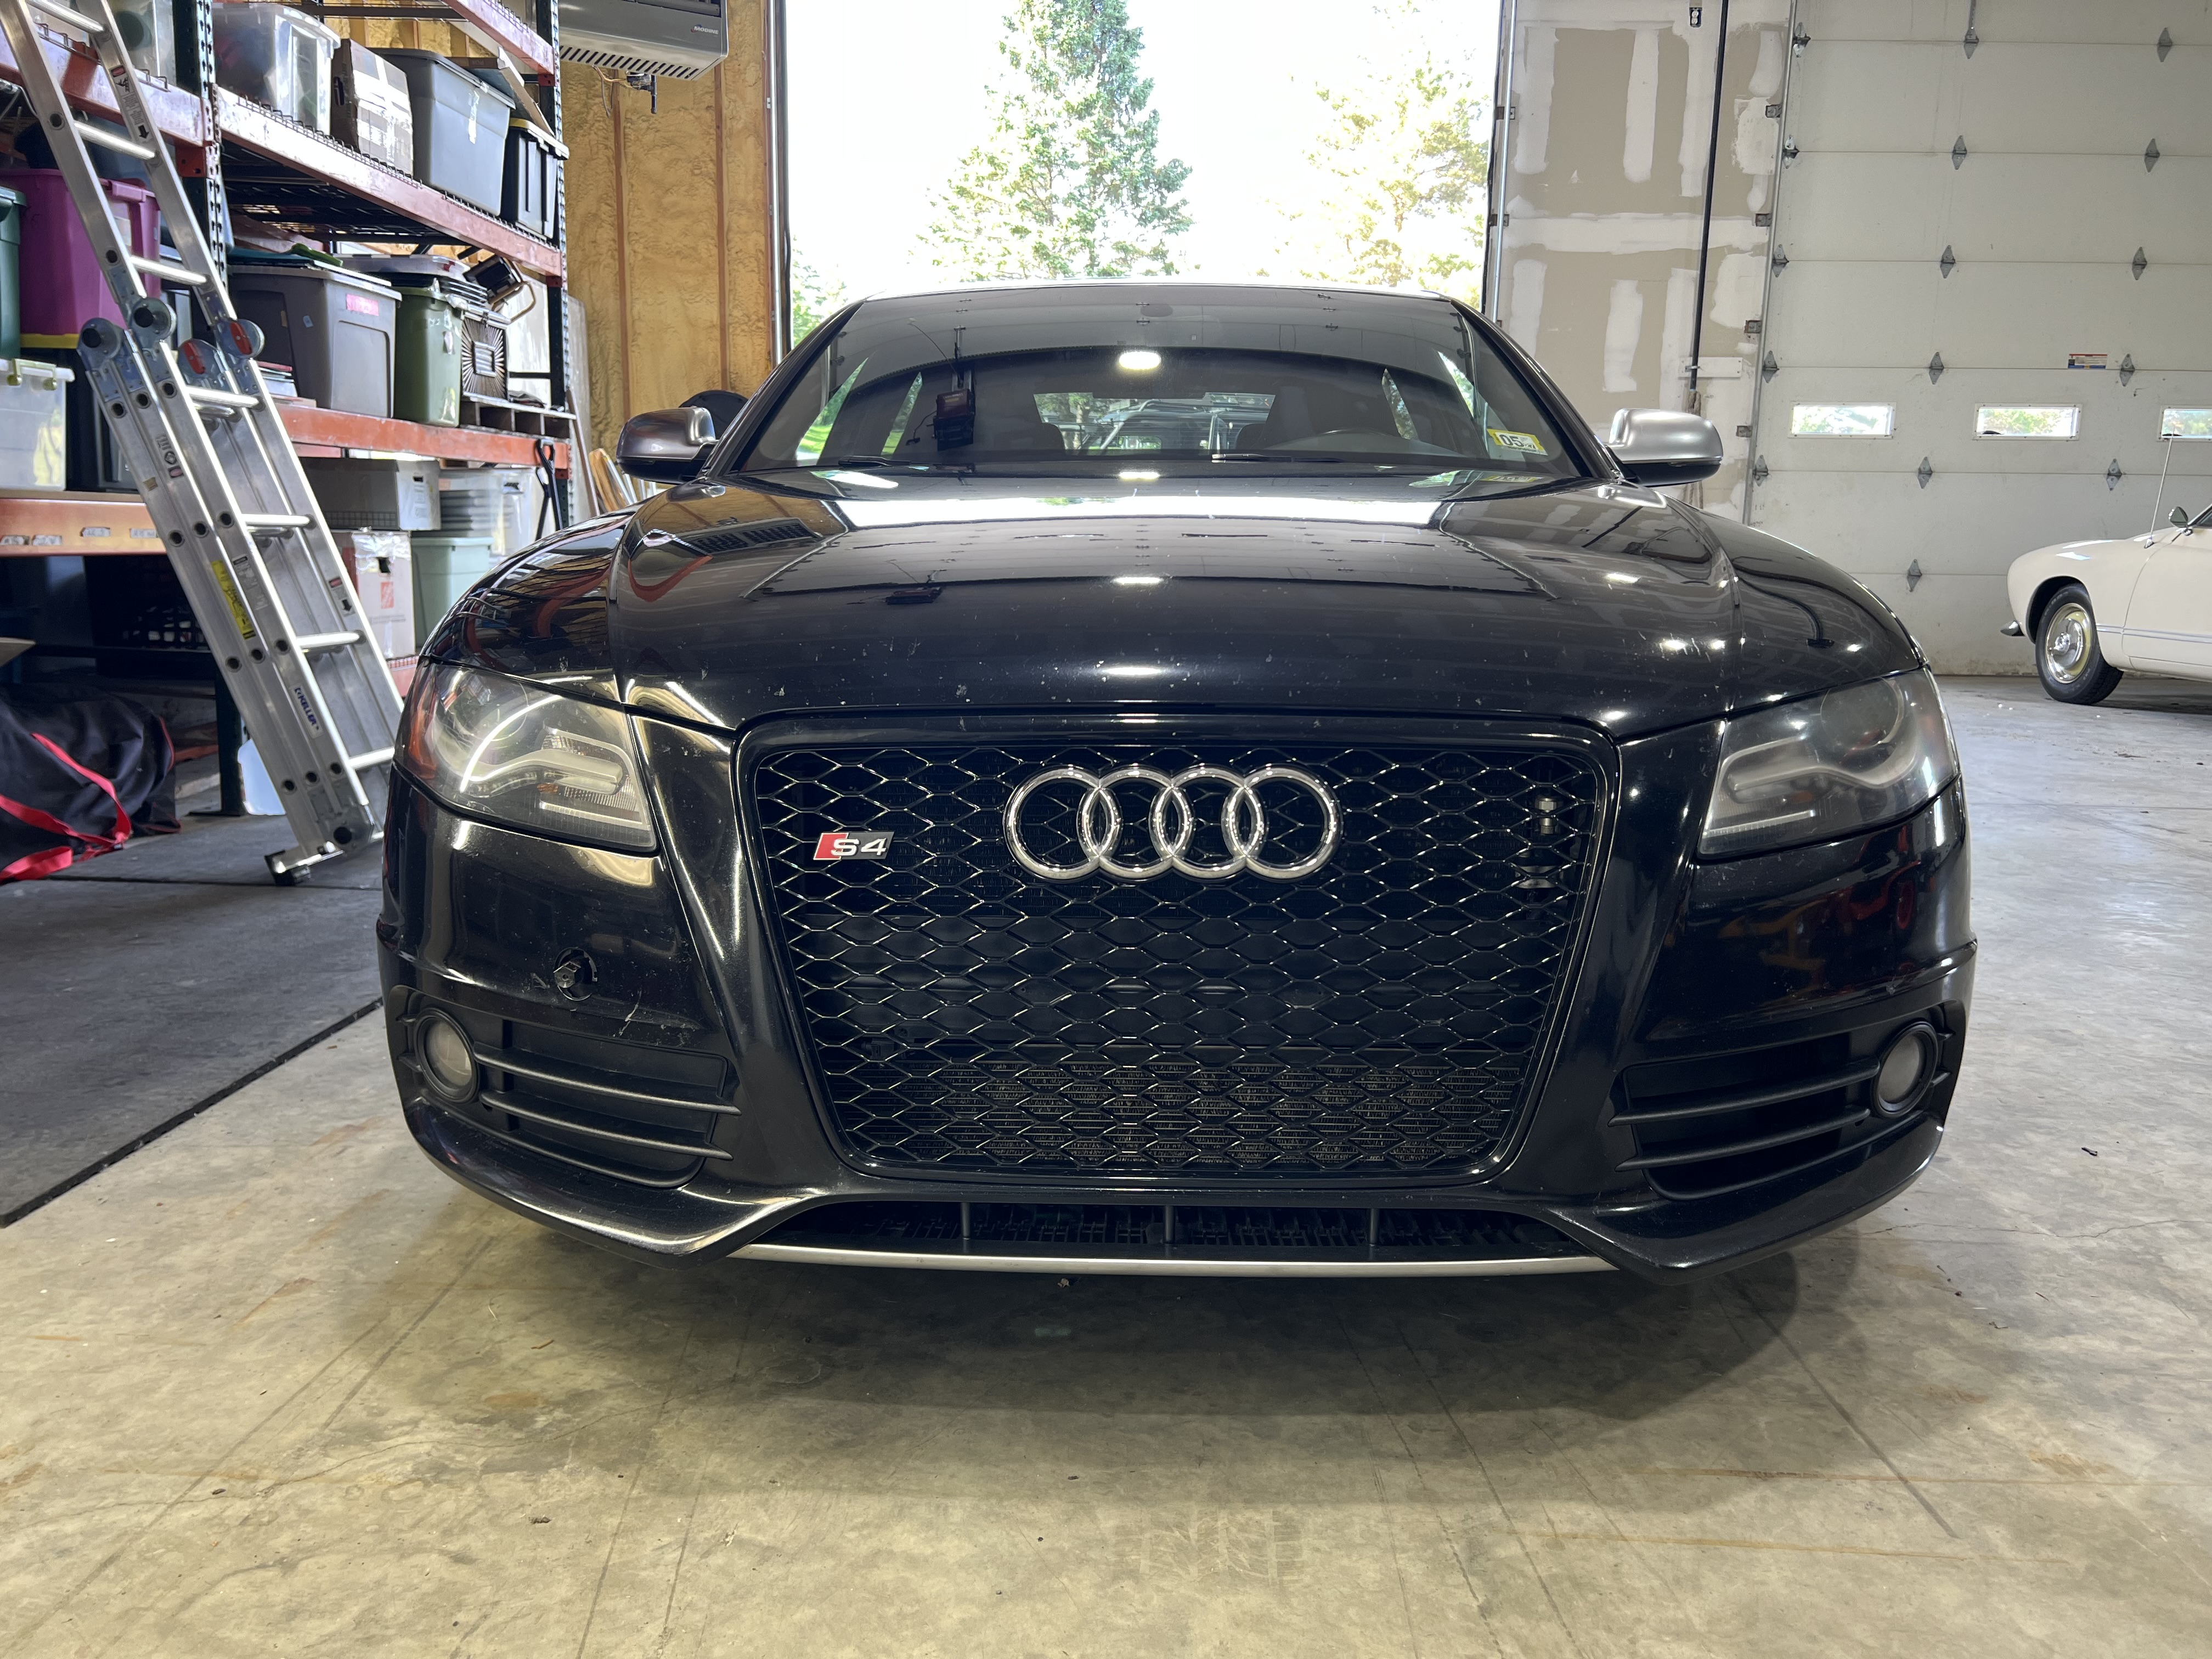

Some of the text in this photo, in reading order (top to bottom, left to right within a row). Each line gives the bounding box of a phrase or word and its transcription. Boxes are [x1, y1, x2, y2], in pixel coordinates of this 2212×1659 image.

[694, 26, 719, 34] MODINE
[1499, 435, 1524, 447] 05
[831, 837, 888, 856] S4
